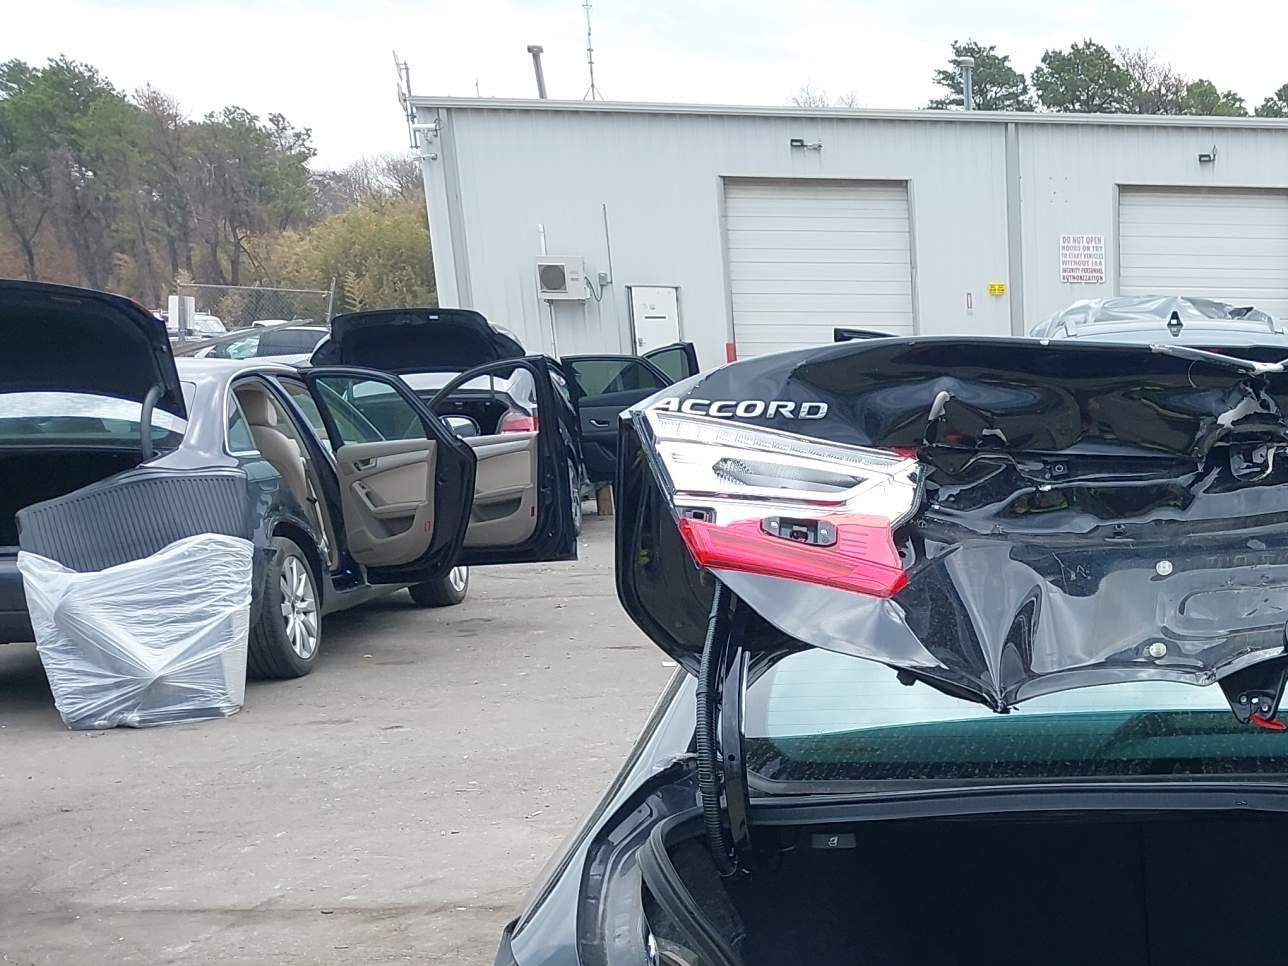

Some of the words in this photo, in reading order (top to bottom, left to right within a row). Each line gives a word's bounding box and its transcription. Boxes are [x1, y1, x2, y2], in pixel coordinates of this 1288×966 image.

[1062, 236, 1071, 244] DO
[1072, 236, 1084, 244] NOT
[1086, 236, 1101, 244] OPEN
[654, 397, 829, 420] ACCORD
